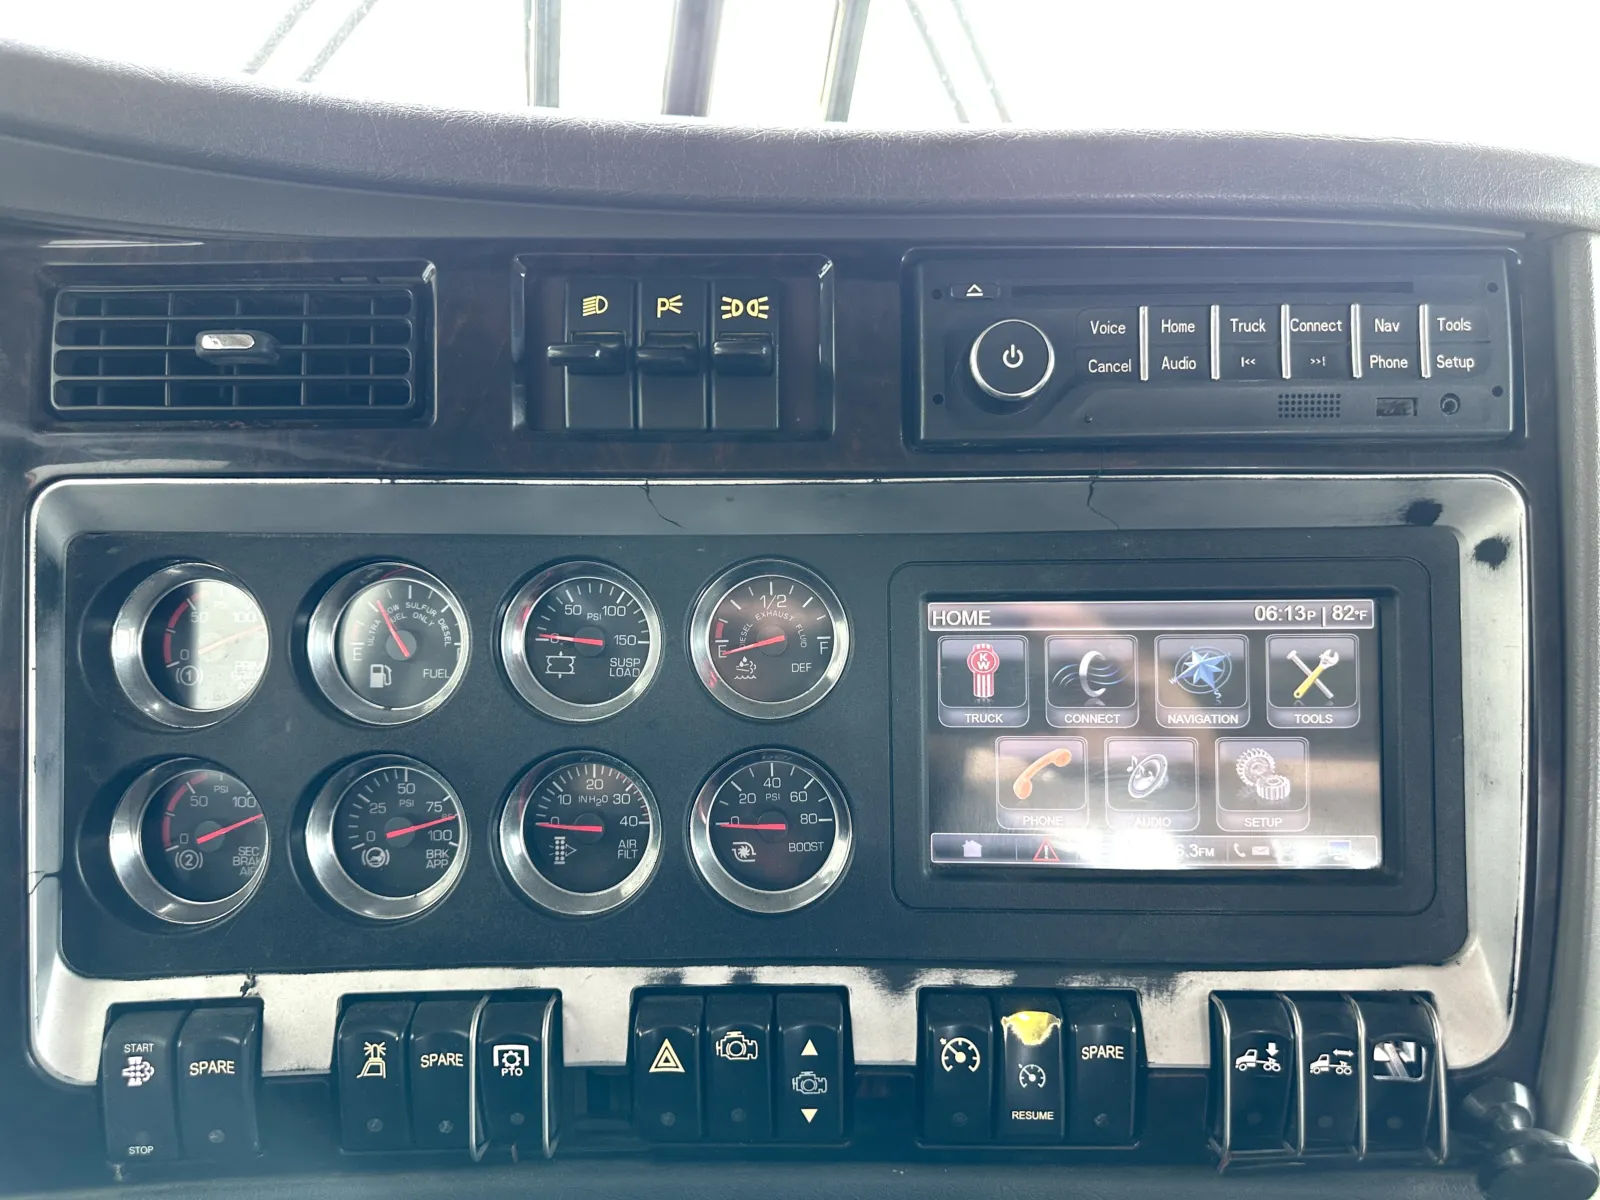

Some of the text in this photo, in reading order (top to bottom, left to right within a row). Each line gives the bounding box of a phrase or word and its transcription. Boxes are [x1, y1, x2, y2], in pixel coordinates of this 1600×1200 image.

[1090, 321, 1126, 336] Voice
[1161, 319, 1195, 333] Home
[1230, 318, 1266, 333] Truck
[1290, 318, 1342, 333] Connect
[1374, 319, 1400, 333] Nav
[1436, 317, 1472, 332] Tools
[1088, 358, 1132, 374] Cancel
[1161, 356, 1197, 371] Audio
[1369, 354, 1408, 369] Phone
[1436, 354, 1475, 371] Setup
[759, 594, 787, 610] 1/2
[564, 604, 582, 616] 50
[601, 605, 627, 617] 100
[191, 611, 208, 623] 50
[233, 611, 256, 623] 100
[391, 612, 435, 627] UEL ONLY
[586, 612, 602, 621] PSI
[932, 610, 991, 626] HOME
[367, 602, 452, 647] ULTRA OW SULFUR DIESEL
[754, 609, 795, 622] EXHAUST
[795, 623, 807, 648] FLUID
[613, 634, 637, 646] 150
[353, 647, 363, 661] E
[718, 644, 727, 658] E
[819, 641, 828, 655] F
[180, 649, 190, 661] 0
[979, 652, 988, 662] K
[609, 657, 641, 668] SUSP
[791, 663, 812, 673] DEF
[976, 661, 991, 670] W
[423, 669, 450, 679] FUEL
[609, 667, 641, 678] LOAD
[964, 713, 1004, 724] TRUCK
[1064, 713, 1121, 724] CONNECT
[1167, 713, 1239, 725] NAVIGATION
[1294, 713, 1333, 724] TOOLS
[397, 783, 416, 795] 50
[586, 779, 604, 790] 20
[763, 777, 782, 789] 40
[213, 785, 229, 794] PSI
[190, 796, 208, 807] 50
[232, 796, 257, 808] 100
[557, 794, 572, 805] 10
[612, 793, 631, 805] 30
[738, 793, 757, 804] 20
[765, 793, 781, 802] PSI
[790, 791, 808, 803] 60
[369, 802, 387, 814] 25
[399, 799, 415, 808] PSI
[425, 801, 443, 813] 75
[619, 815, 639, 827] 40
[800, 813, 818, 825] 80
[1022, 815, 1064, 827] PHONE
[1133, 816, 1172, 828] AUDIO
[1244, 816, 1283, 828] SETUP
[179, 833, 189, 845] 0
[366, 830, 376, 842] 0
[427, 829, 453, 841] 100
[618, 839, 637, 849] AIR
[788, 841, 824, 853] BOOST
[238, 846, 260, 856] SEC
[426, 849, 449, 859] BRK
[617, 849, 639, 859] FILT
[426, 859, 449, 869] APP
[124, 1043, 154, 1053] START
[1081, 1044, 1125, 1061] SPARE
[420, 1052, 464, 1068] SPARE
[189, 1060, 236, 1075] SPARE
[501, 1068, 523, 1077] PTO
[1011, 1110, 1054, 1121] RESUME
[128, 1145, 154, 1155] STOP
